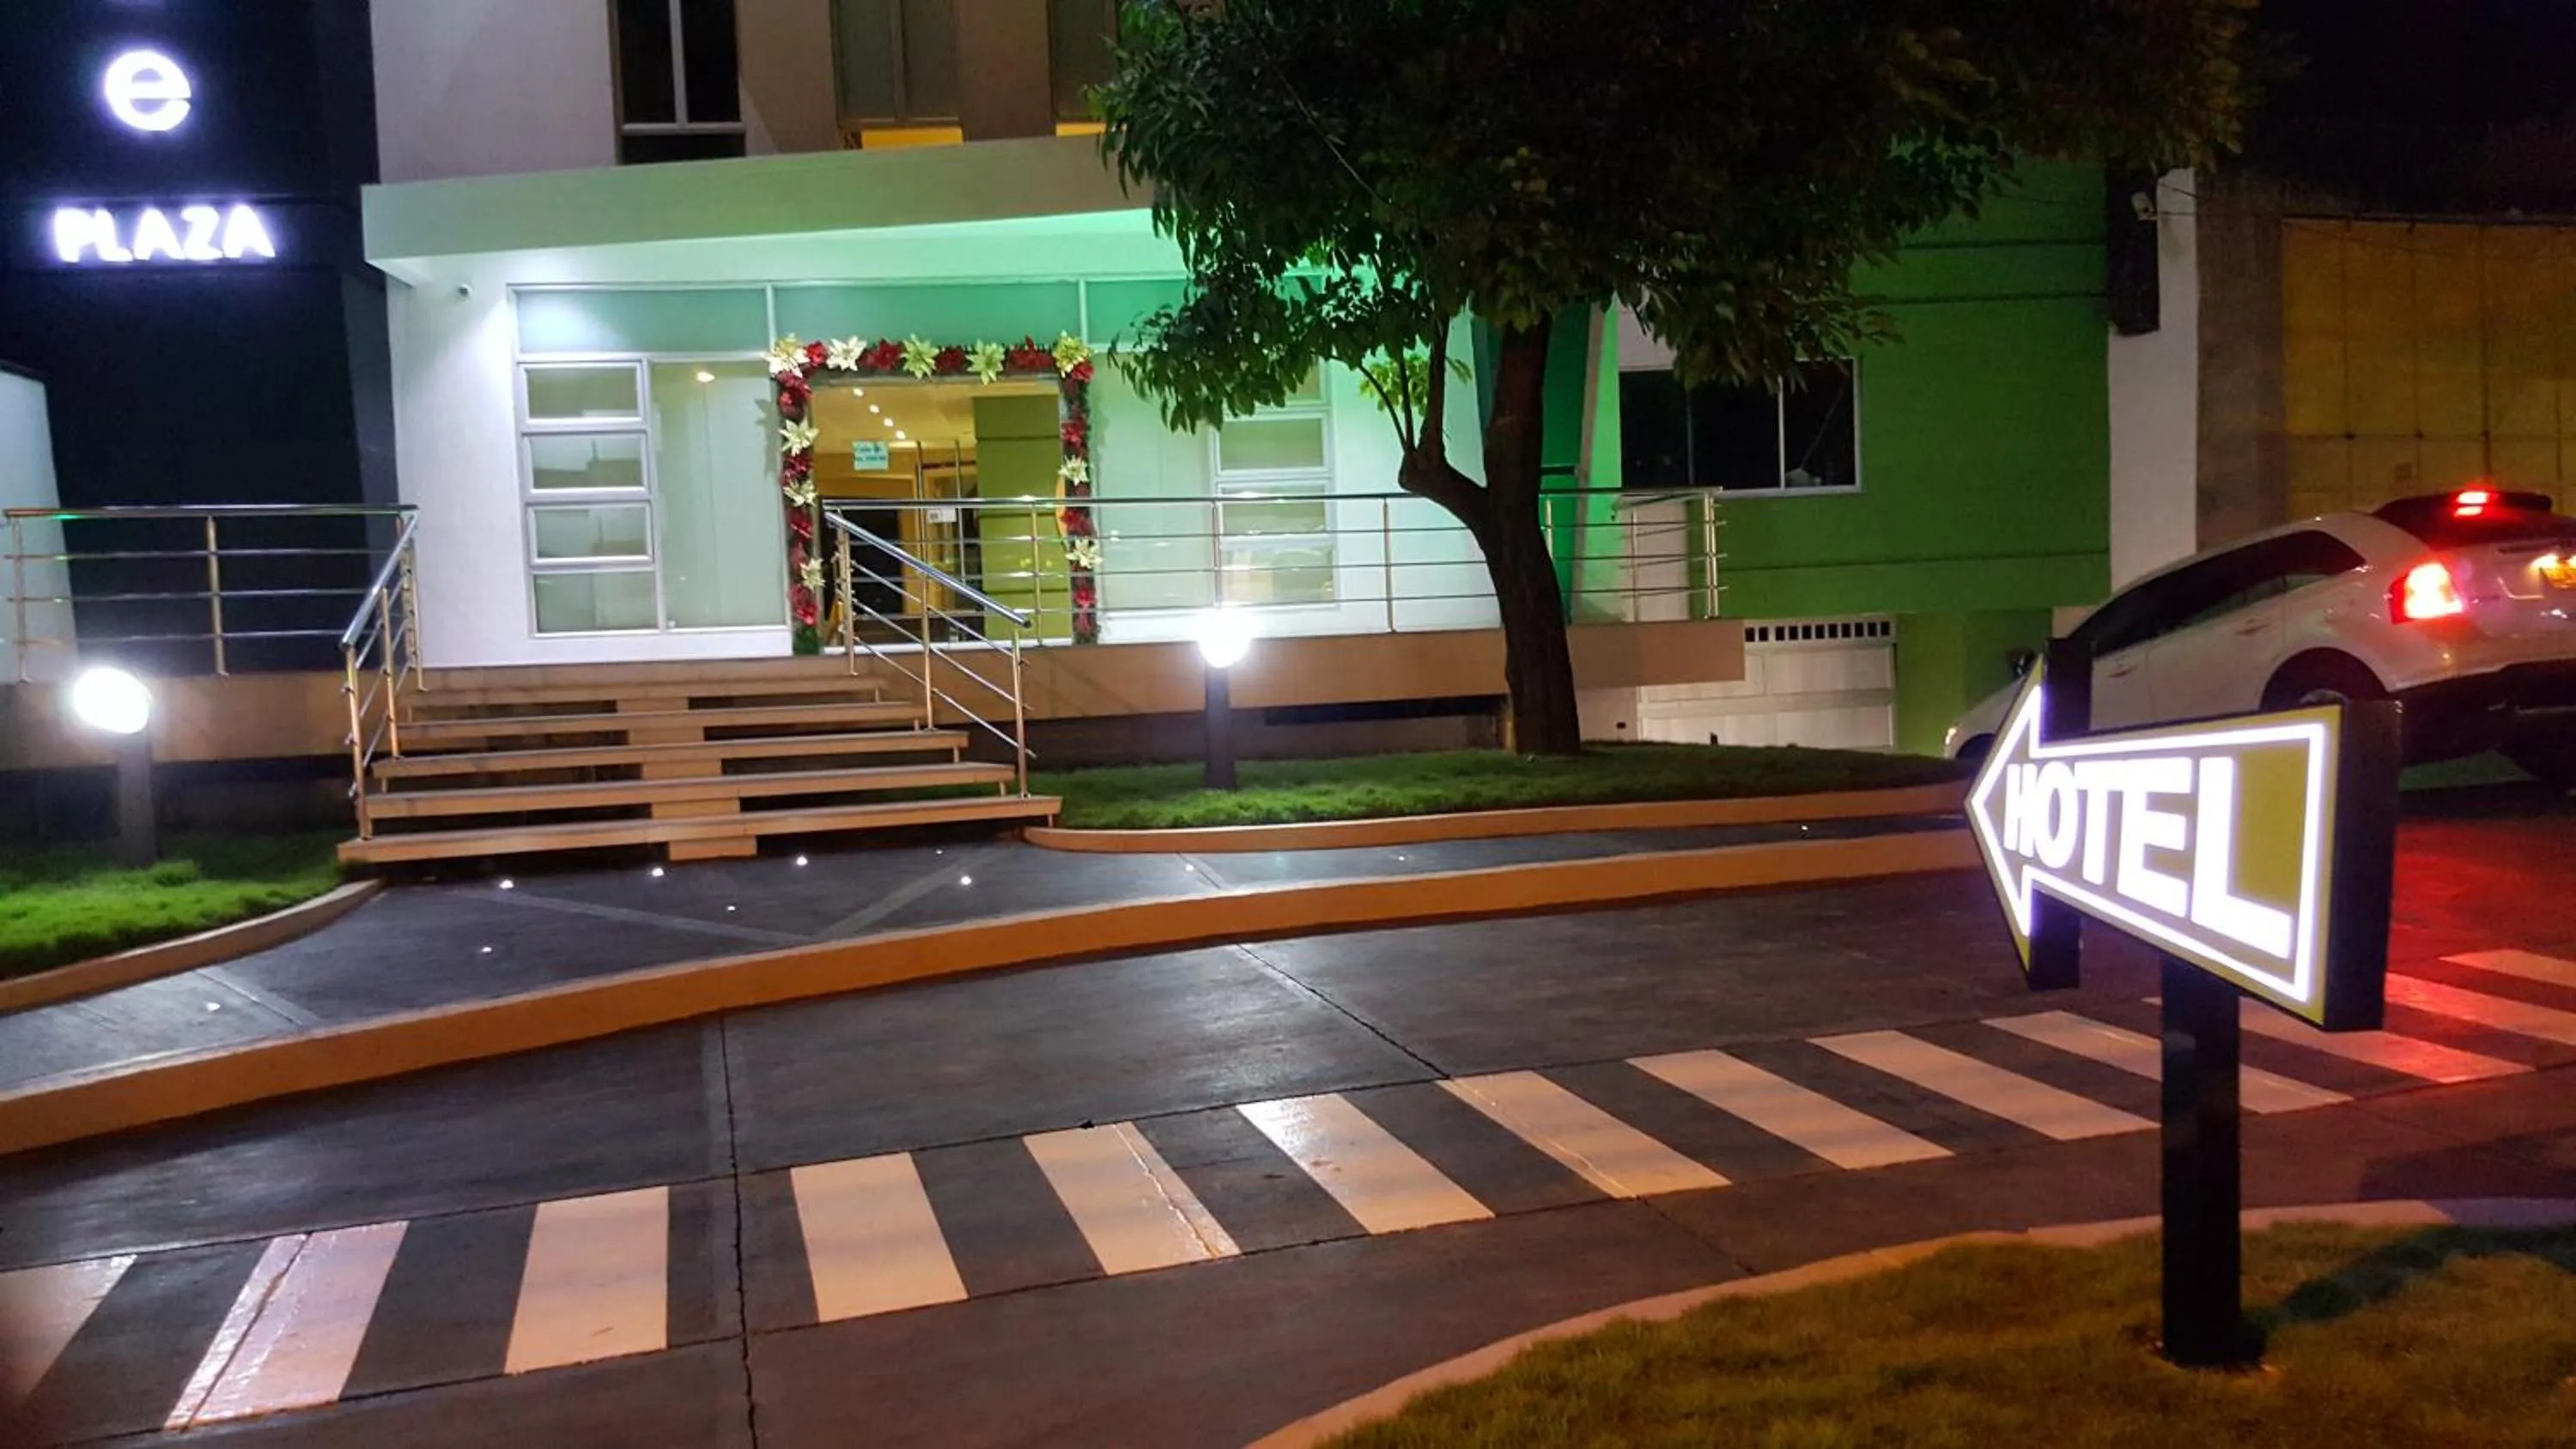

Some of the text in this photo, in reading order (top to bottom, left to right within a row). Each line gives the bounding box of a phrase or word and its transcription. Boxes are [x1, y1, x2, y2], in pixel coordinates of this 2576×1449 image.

[104, 50, 191, 131] e
[53, 203, 276, 263] PLAZA
[2002, 756, 2293, 960] HOTEL
